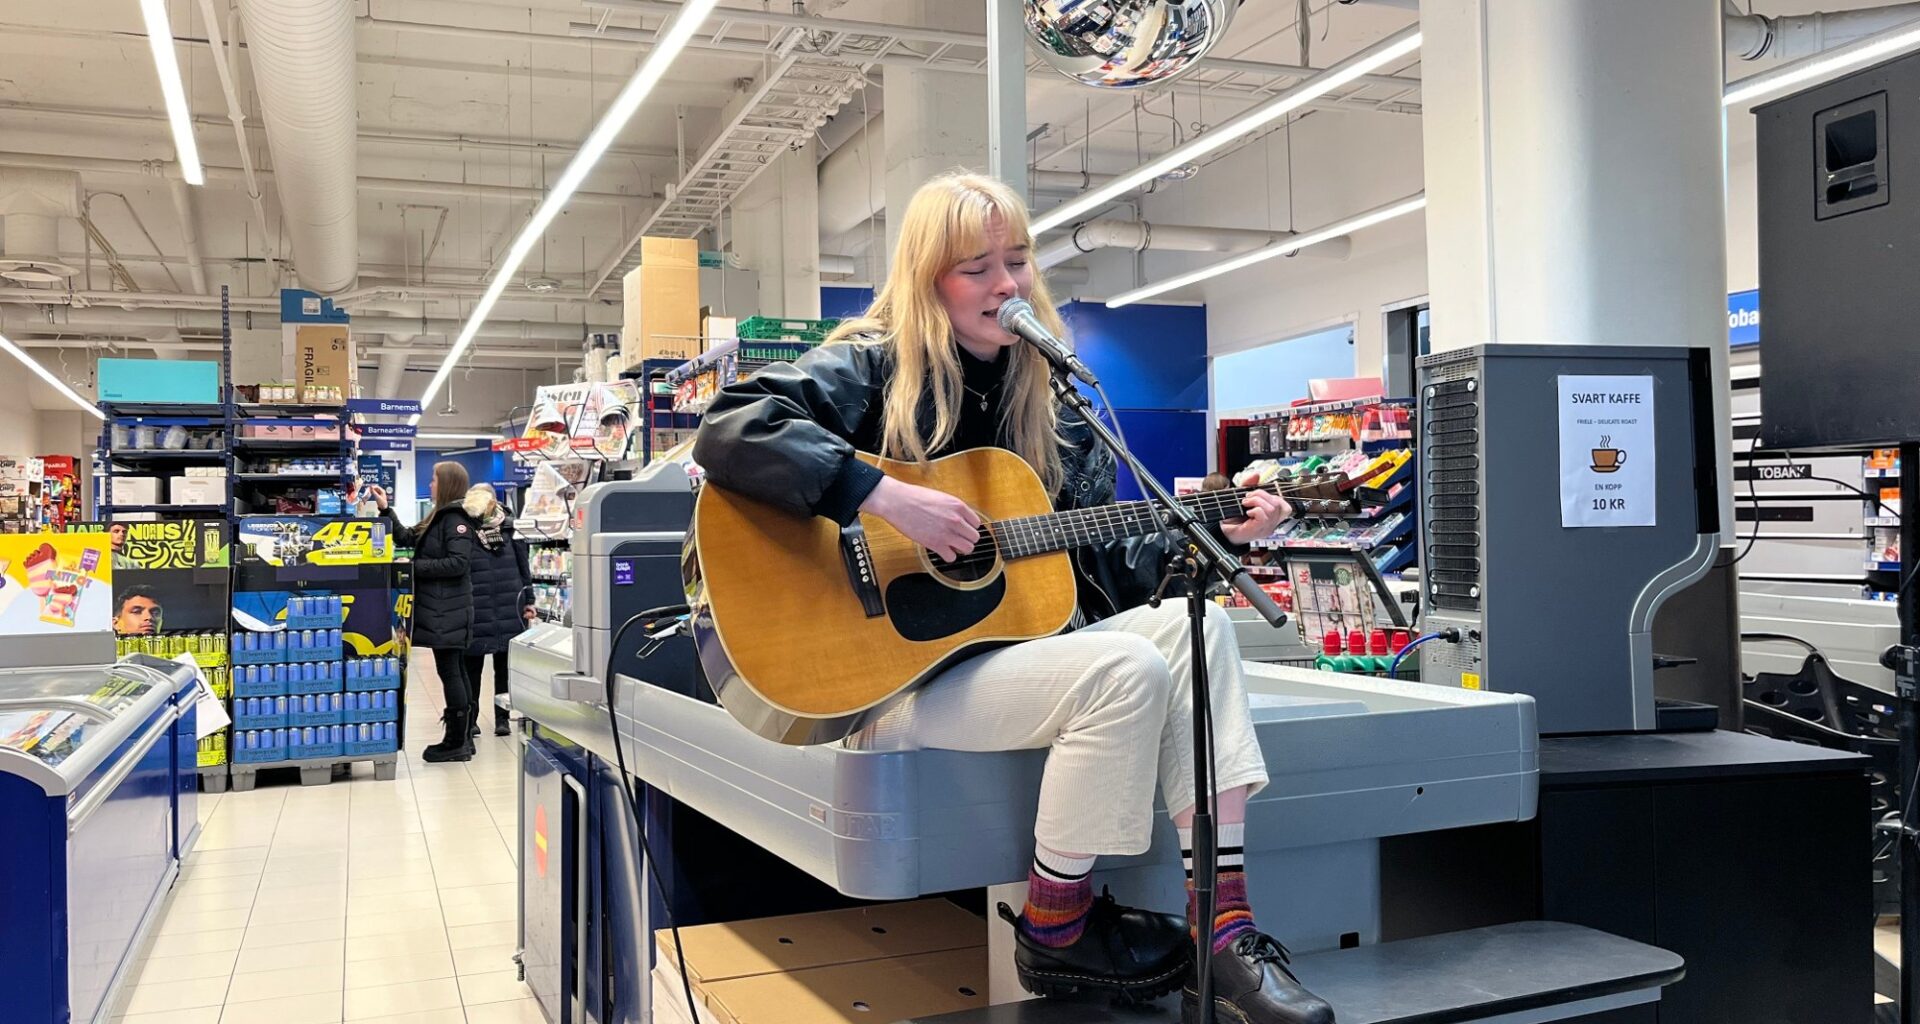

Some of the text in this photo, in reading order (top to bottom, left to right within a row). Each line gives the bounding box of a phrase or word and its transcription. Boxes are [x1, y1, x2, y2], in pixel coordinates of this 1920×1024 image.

[1728, 308, 1759, 328] oba
[304, 347, 314, 385] FRAGIL
[1571, 393, 1641, 404] SVART KAFFE
[380, 402, 419, 412] Barnemat
[367, 426, 414, 435] Barneartikler
[1605, 483, 1623, 491] KOPP
[1592, 499, 1626, 511] 10 KR
[311, 521, 374, 546] 46
[394, 594, 415, 618] 46
